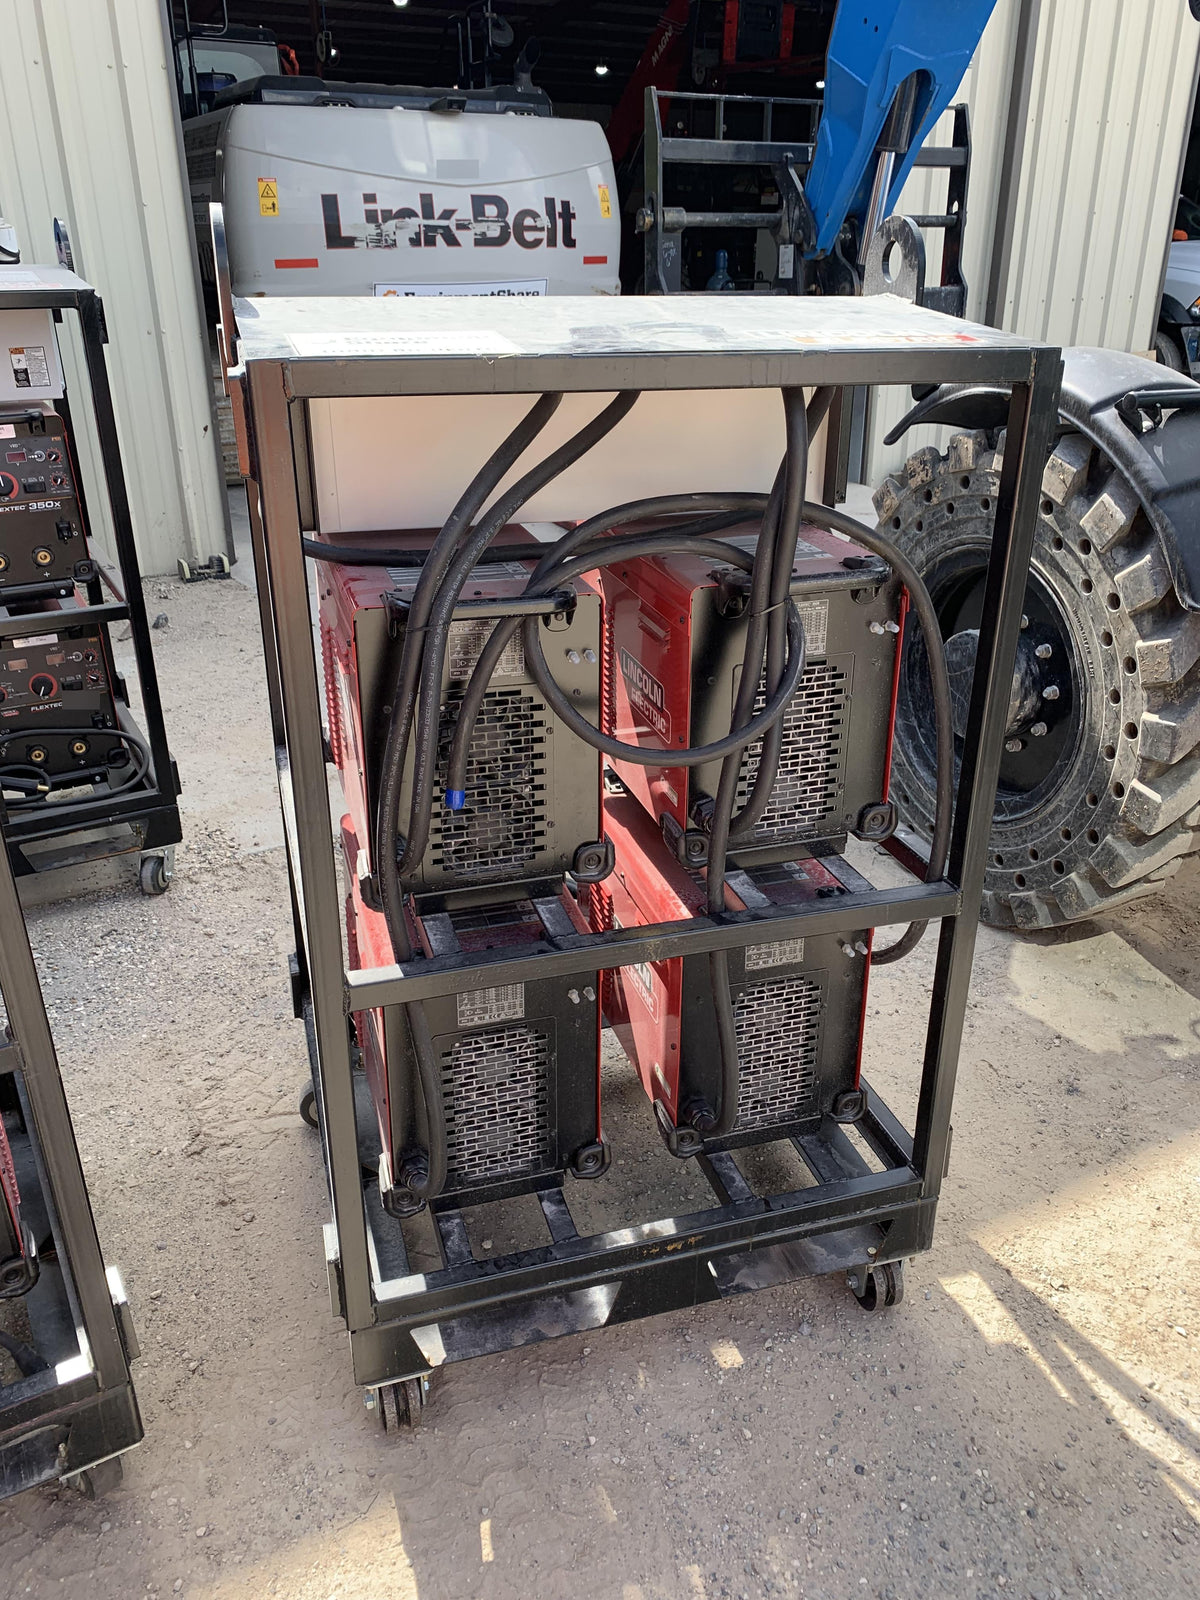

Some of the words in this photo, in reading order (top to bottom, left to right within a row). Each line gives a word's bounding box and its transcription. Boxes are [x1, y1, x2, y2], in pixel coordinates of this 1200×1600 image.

[321, 193, 576, 250] Link-Belt
[622, 653, 662, 709] LINCOLN
[31, 702, 62, 712] FLEXTEC
[631, 687, 666, 734] ELECTRIC
